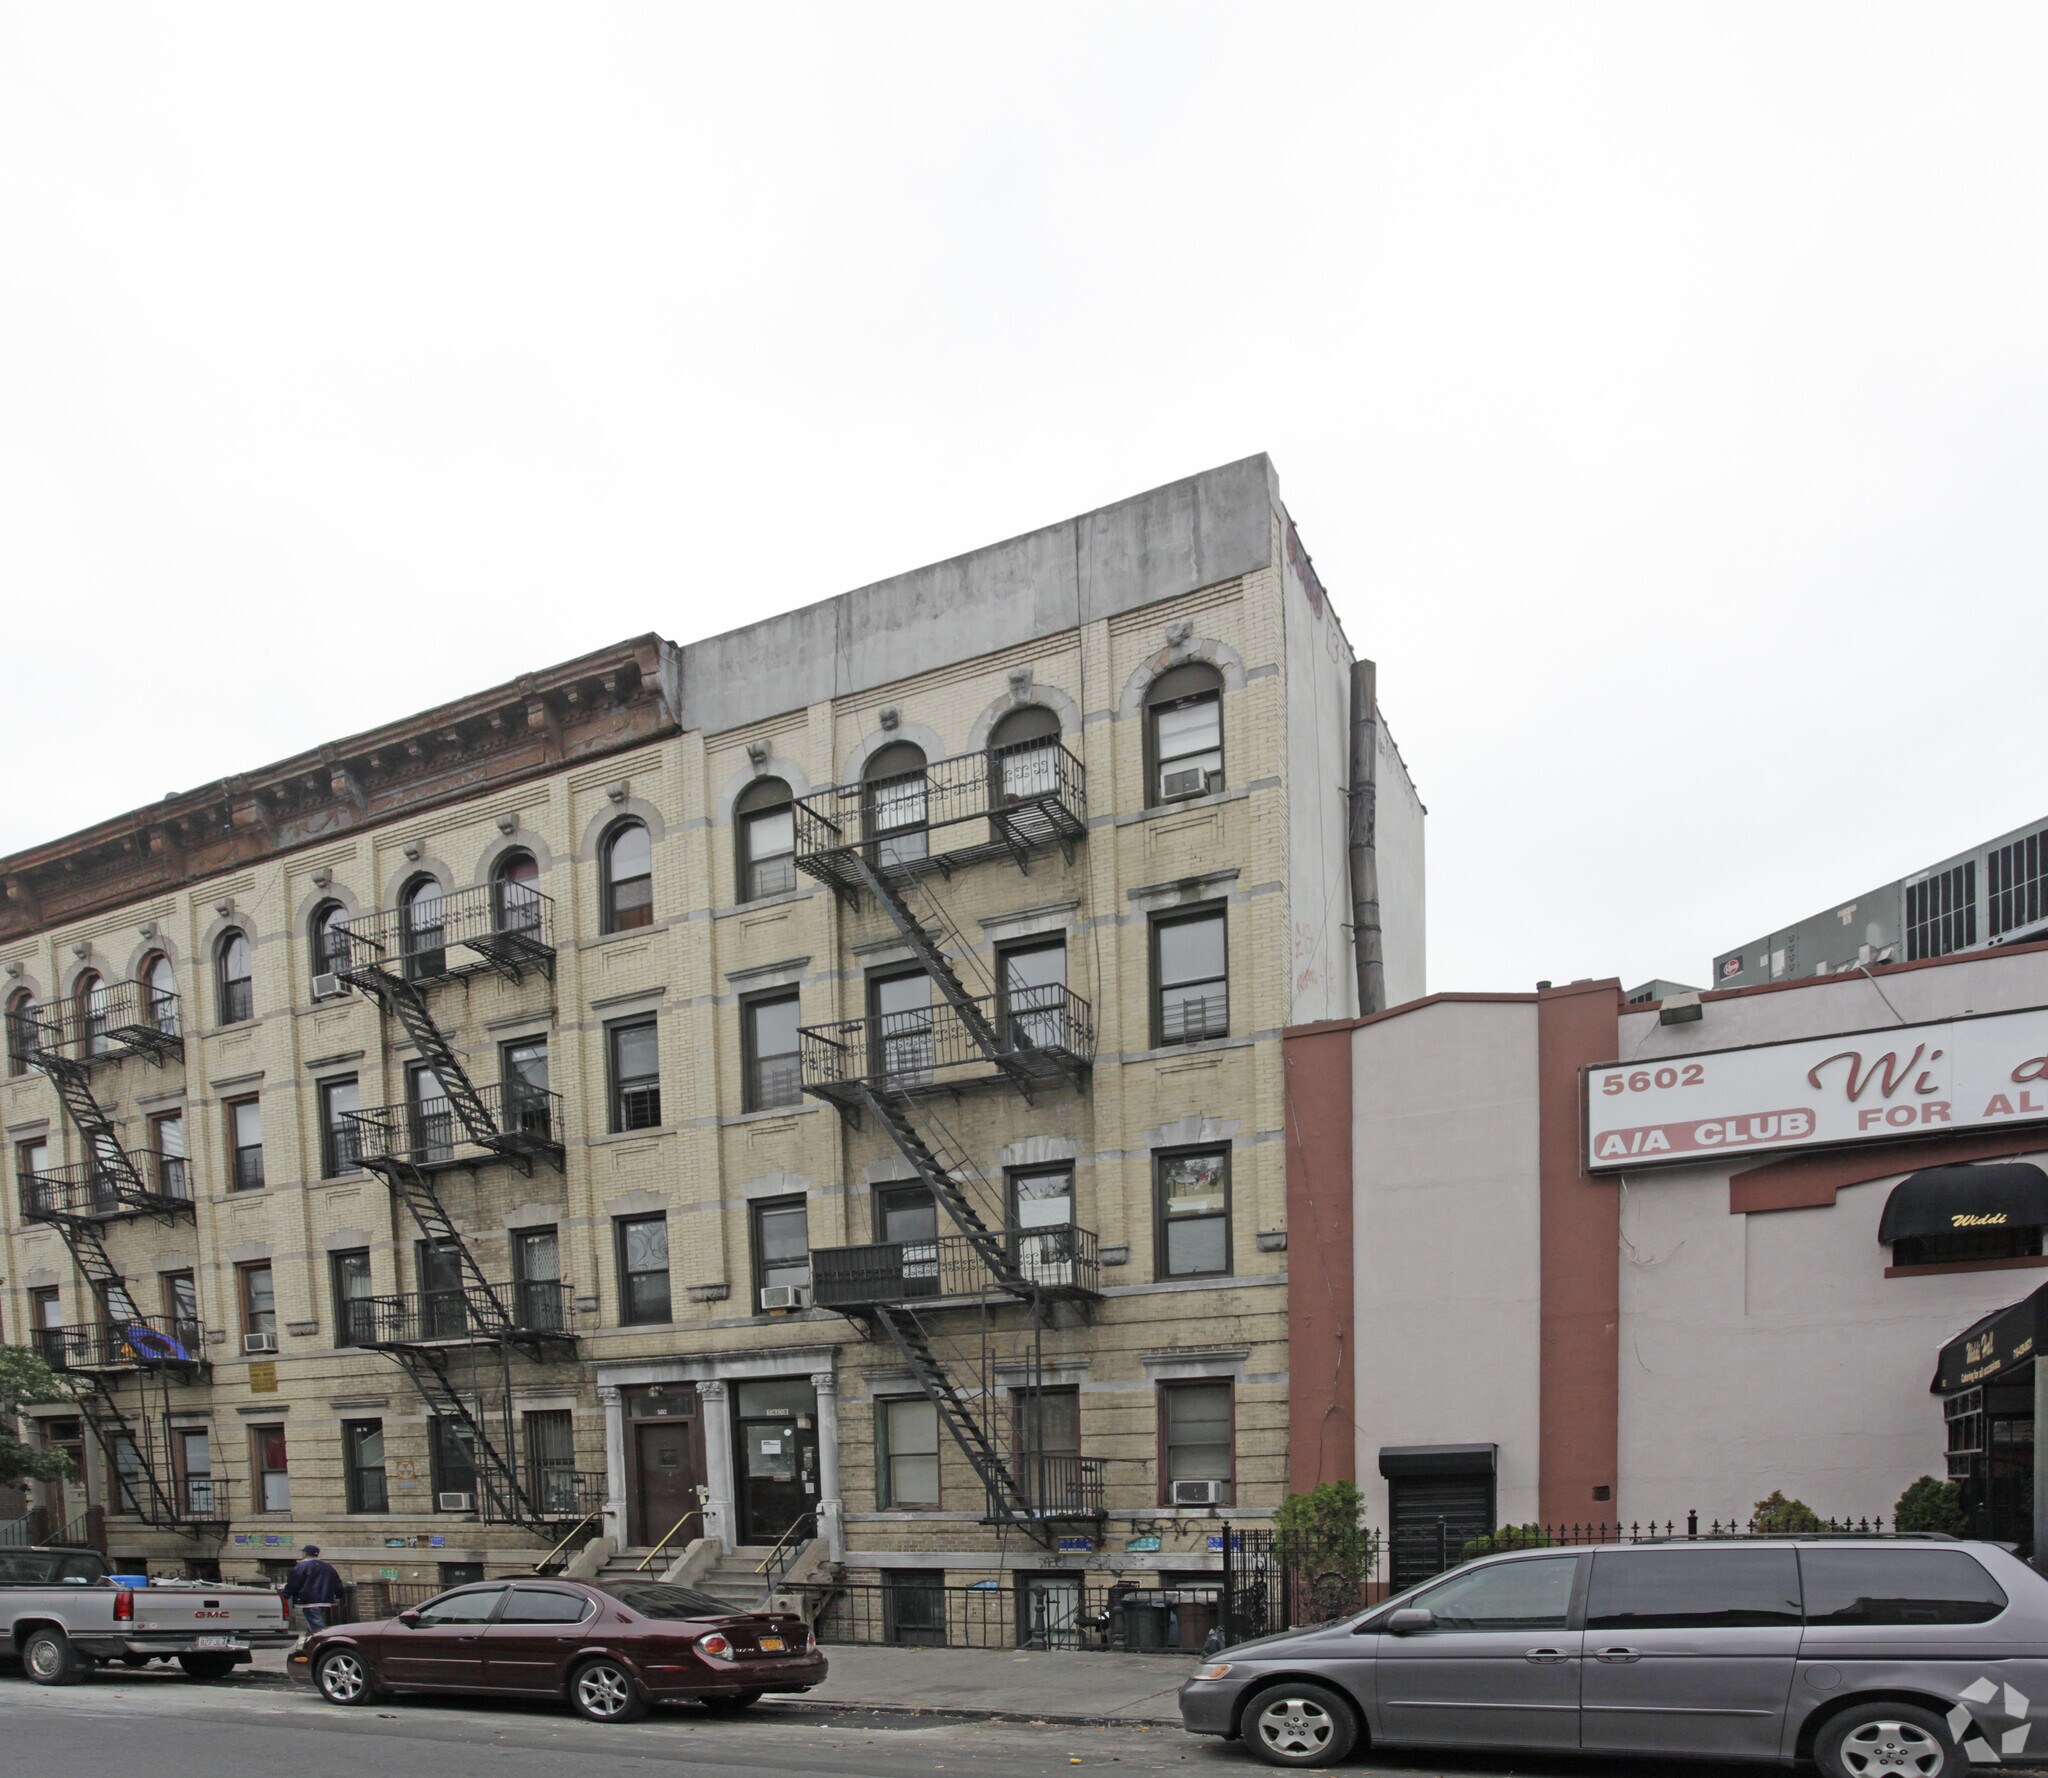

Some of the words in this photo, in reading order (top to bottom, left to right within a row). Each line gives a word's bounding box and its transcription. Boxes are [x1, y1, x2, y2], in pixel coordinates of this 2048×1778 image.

[1602, 1064, 1705, 1096] 5602
[1858, 1100, 1952, 1131] FOR
[1600, 1130, 1671, 1157] A/A
[1694, 1113, 1809, 1146] CLUB
[1951, 1212, 2007, 1228] Widdi
